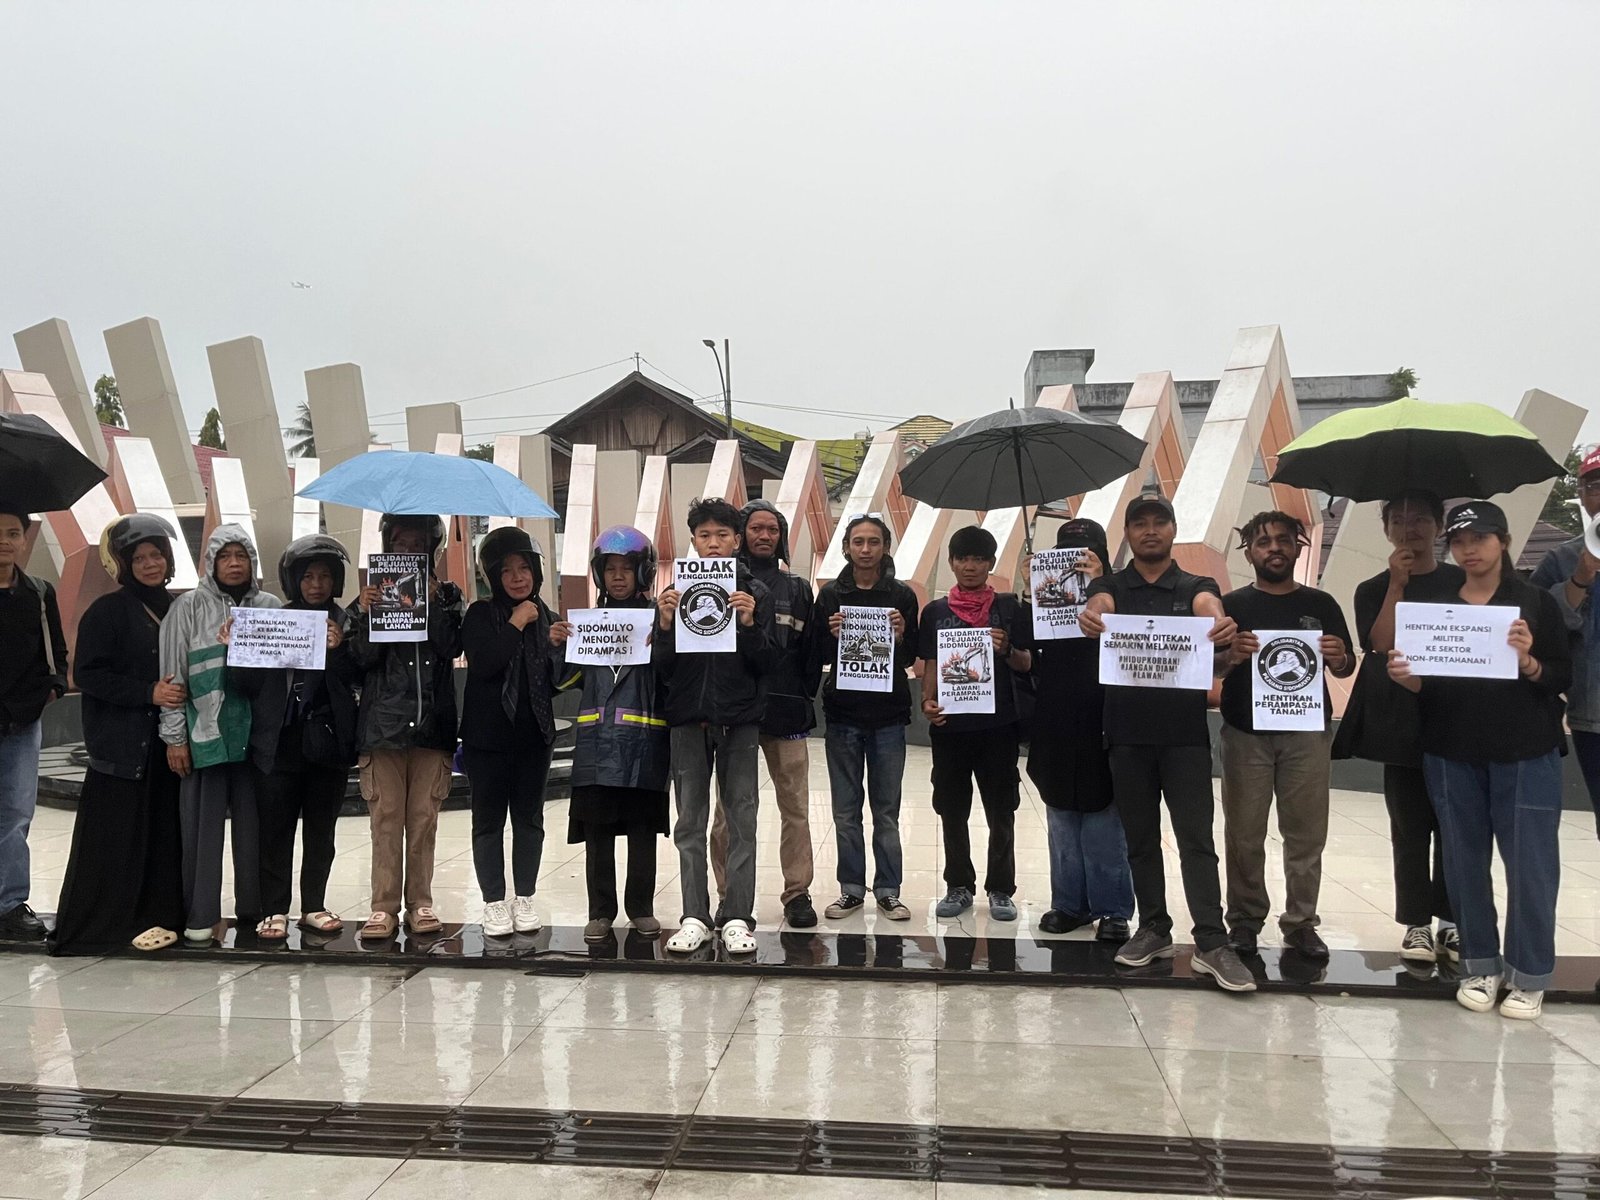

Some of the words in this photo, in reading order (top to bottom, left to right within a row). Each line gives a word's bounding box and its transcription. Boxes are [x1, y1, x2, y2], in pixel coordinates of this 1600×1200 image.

[1034, 551, 1085, 559] SOLIDARITAS
[677, 561, 734, 573] TOLAK
[691, 584, 720, 592] SOLIDARITAS
[578, 624, 633, 632] SIDOMULYO
[582, 635, 629, 643] MENOLAK
[1111, 633, 1150, 641] SEMAKIN
[1153, 634, 1190, 642] DITEKAN
[1104, 641, 1143, 649] SEMAKIN
[1146, 643, 1191, 651] MELAWAN
[1271, 639, 1303, 647] SOLIDARITAS
[840, 661, 889, 673] TOLAK
